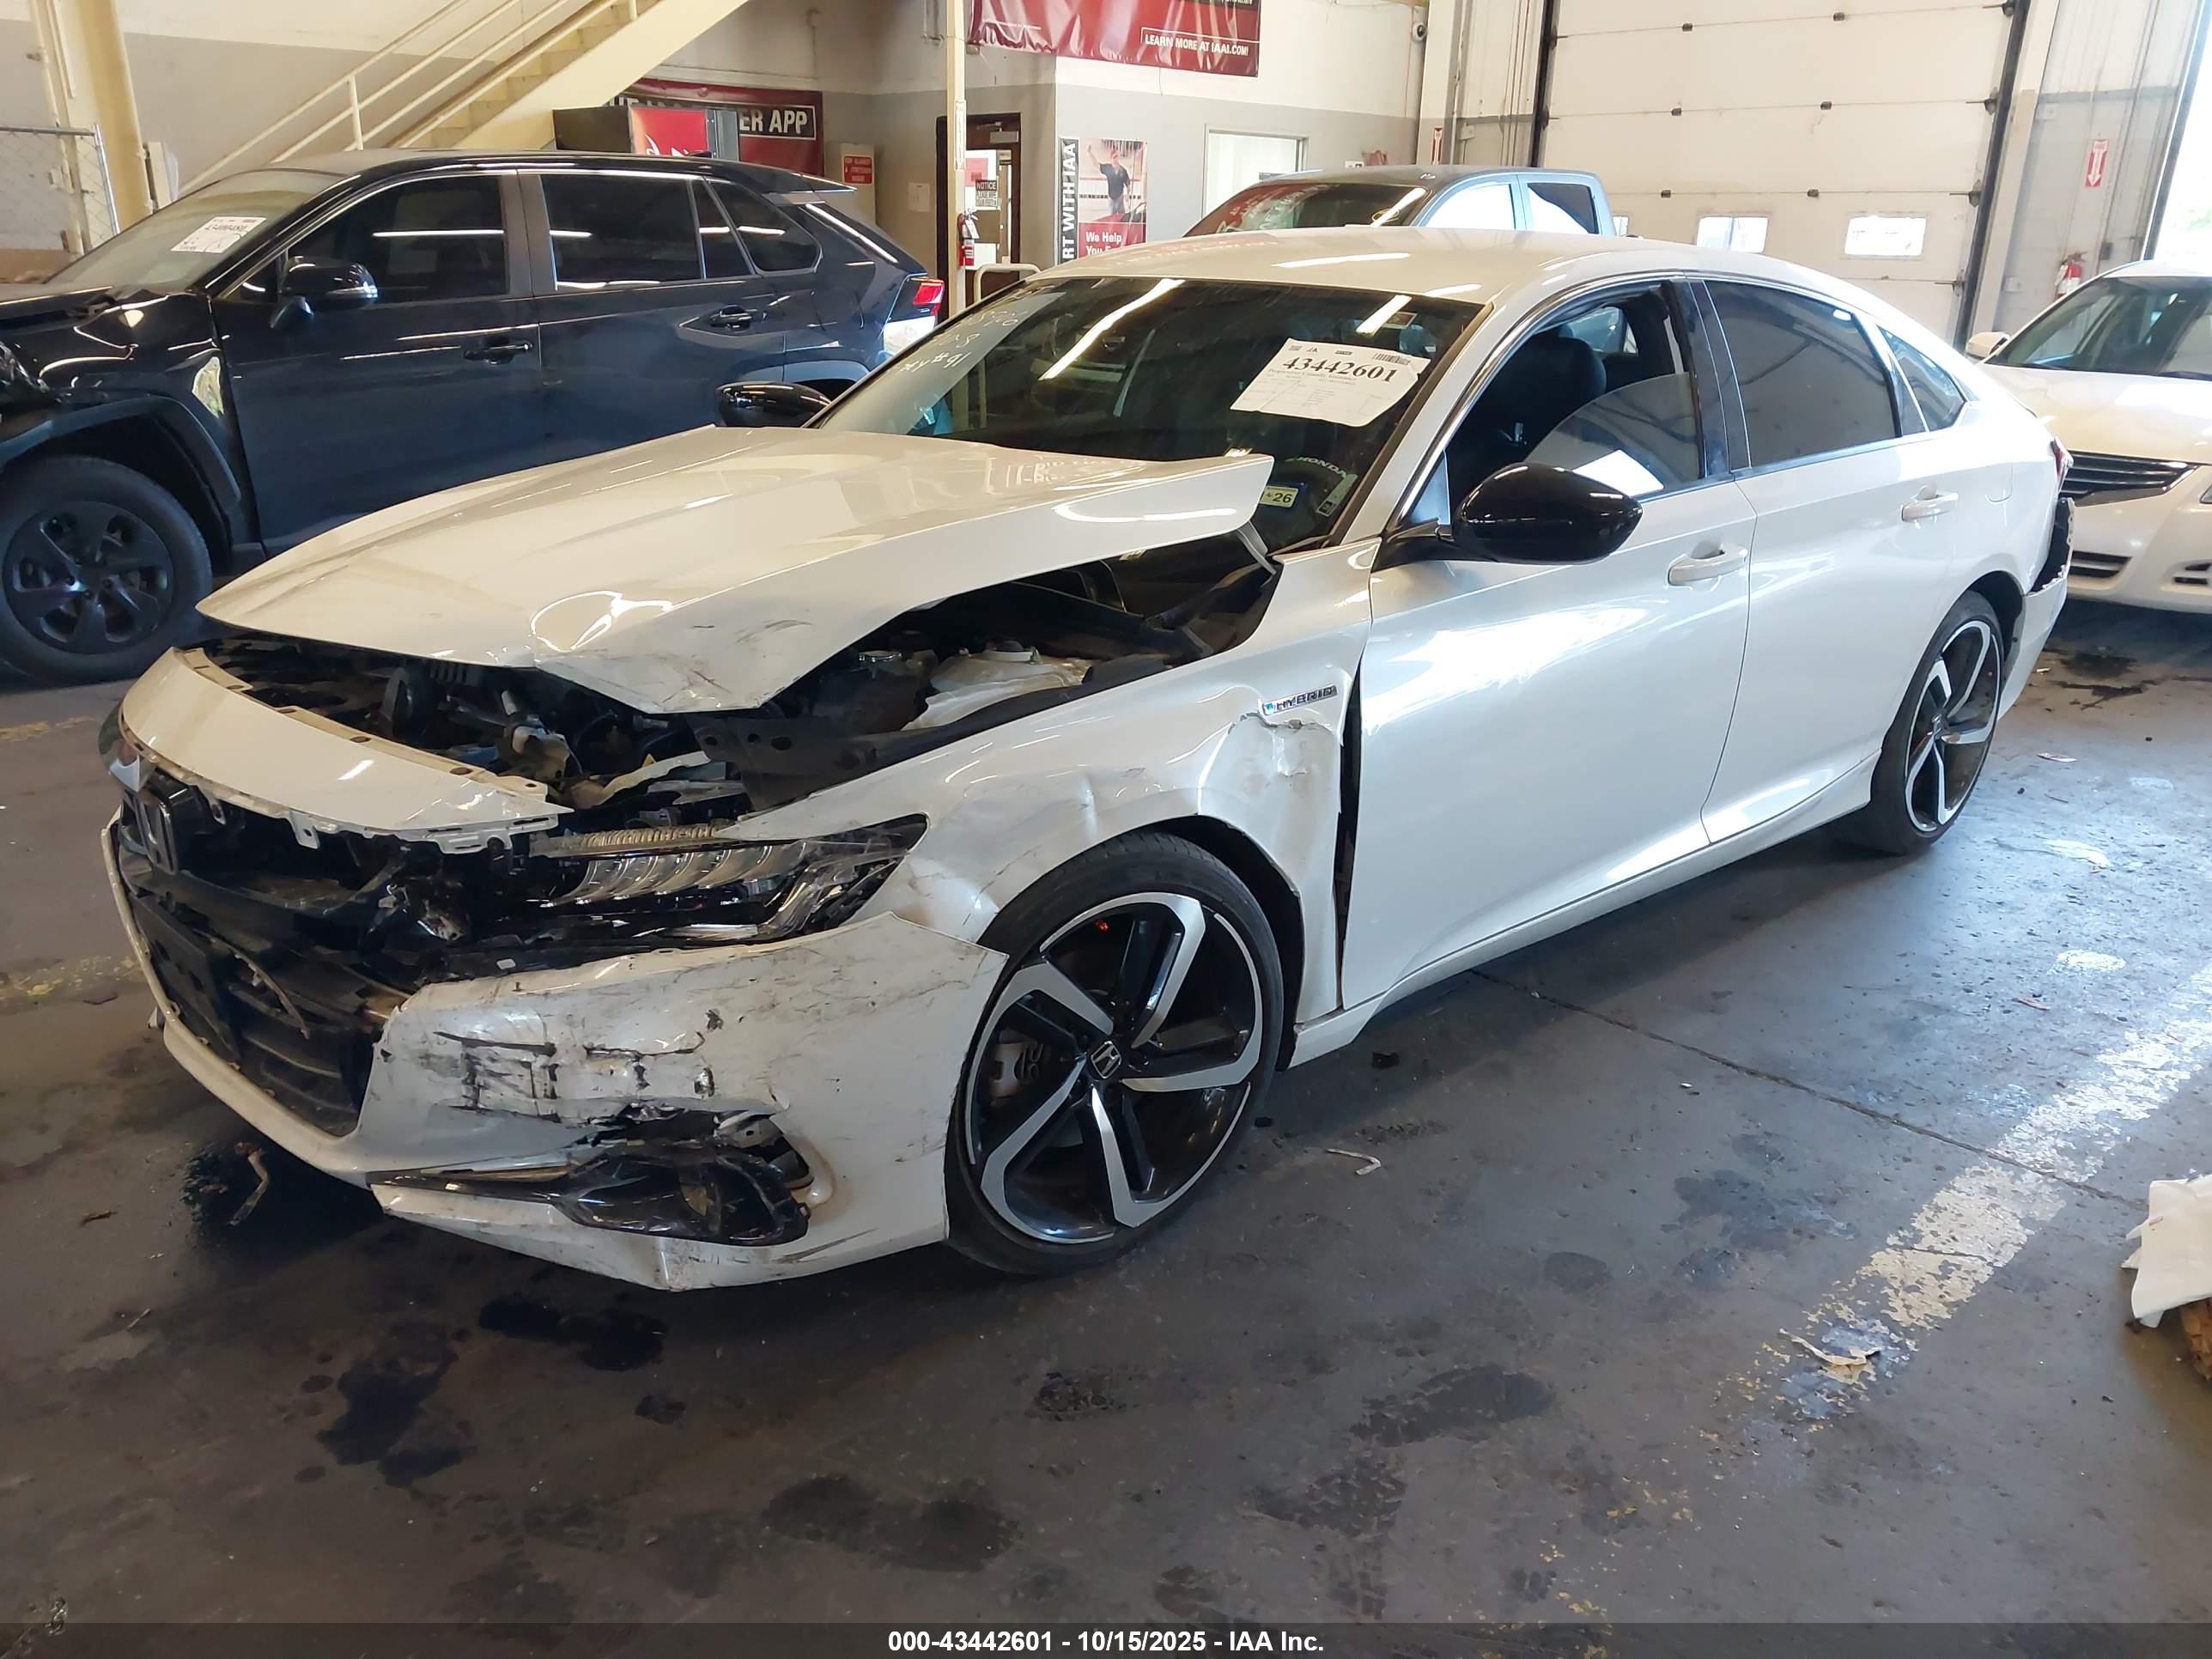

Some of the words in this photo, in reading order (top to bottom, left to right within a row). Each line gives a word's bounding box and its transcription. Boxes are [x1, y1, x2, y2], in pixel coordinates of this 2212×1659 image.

[1145, 34, 1173, 47] LEARN
[1176, 38, 1198, 51] MORE
[1199, 41, 1210, 52] AT
[1211, 42, 1249, 56] IAAI.COM!
[769, 109, 808, 134] APP
[1062, 143, 1076, 176] IAA
[1062, 183, 1075, 231] WITH
[1085, 231, 1098, 242] We
[1102, 231, 1122, 243] Help
[1282, 356, 1398, 383] 43442601
[1297, 456, 1347, 478] HONDA
[1272, 492, 1293, 503] 26
[1276, 687, 1333, 710] HYBRID
